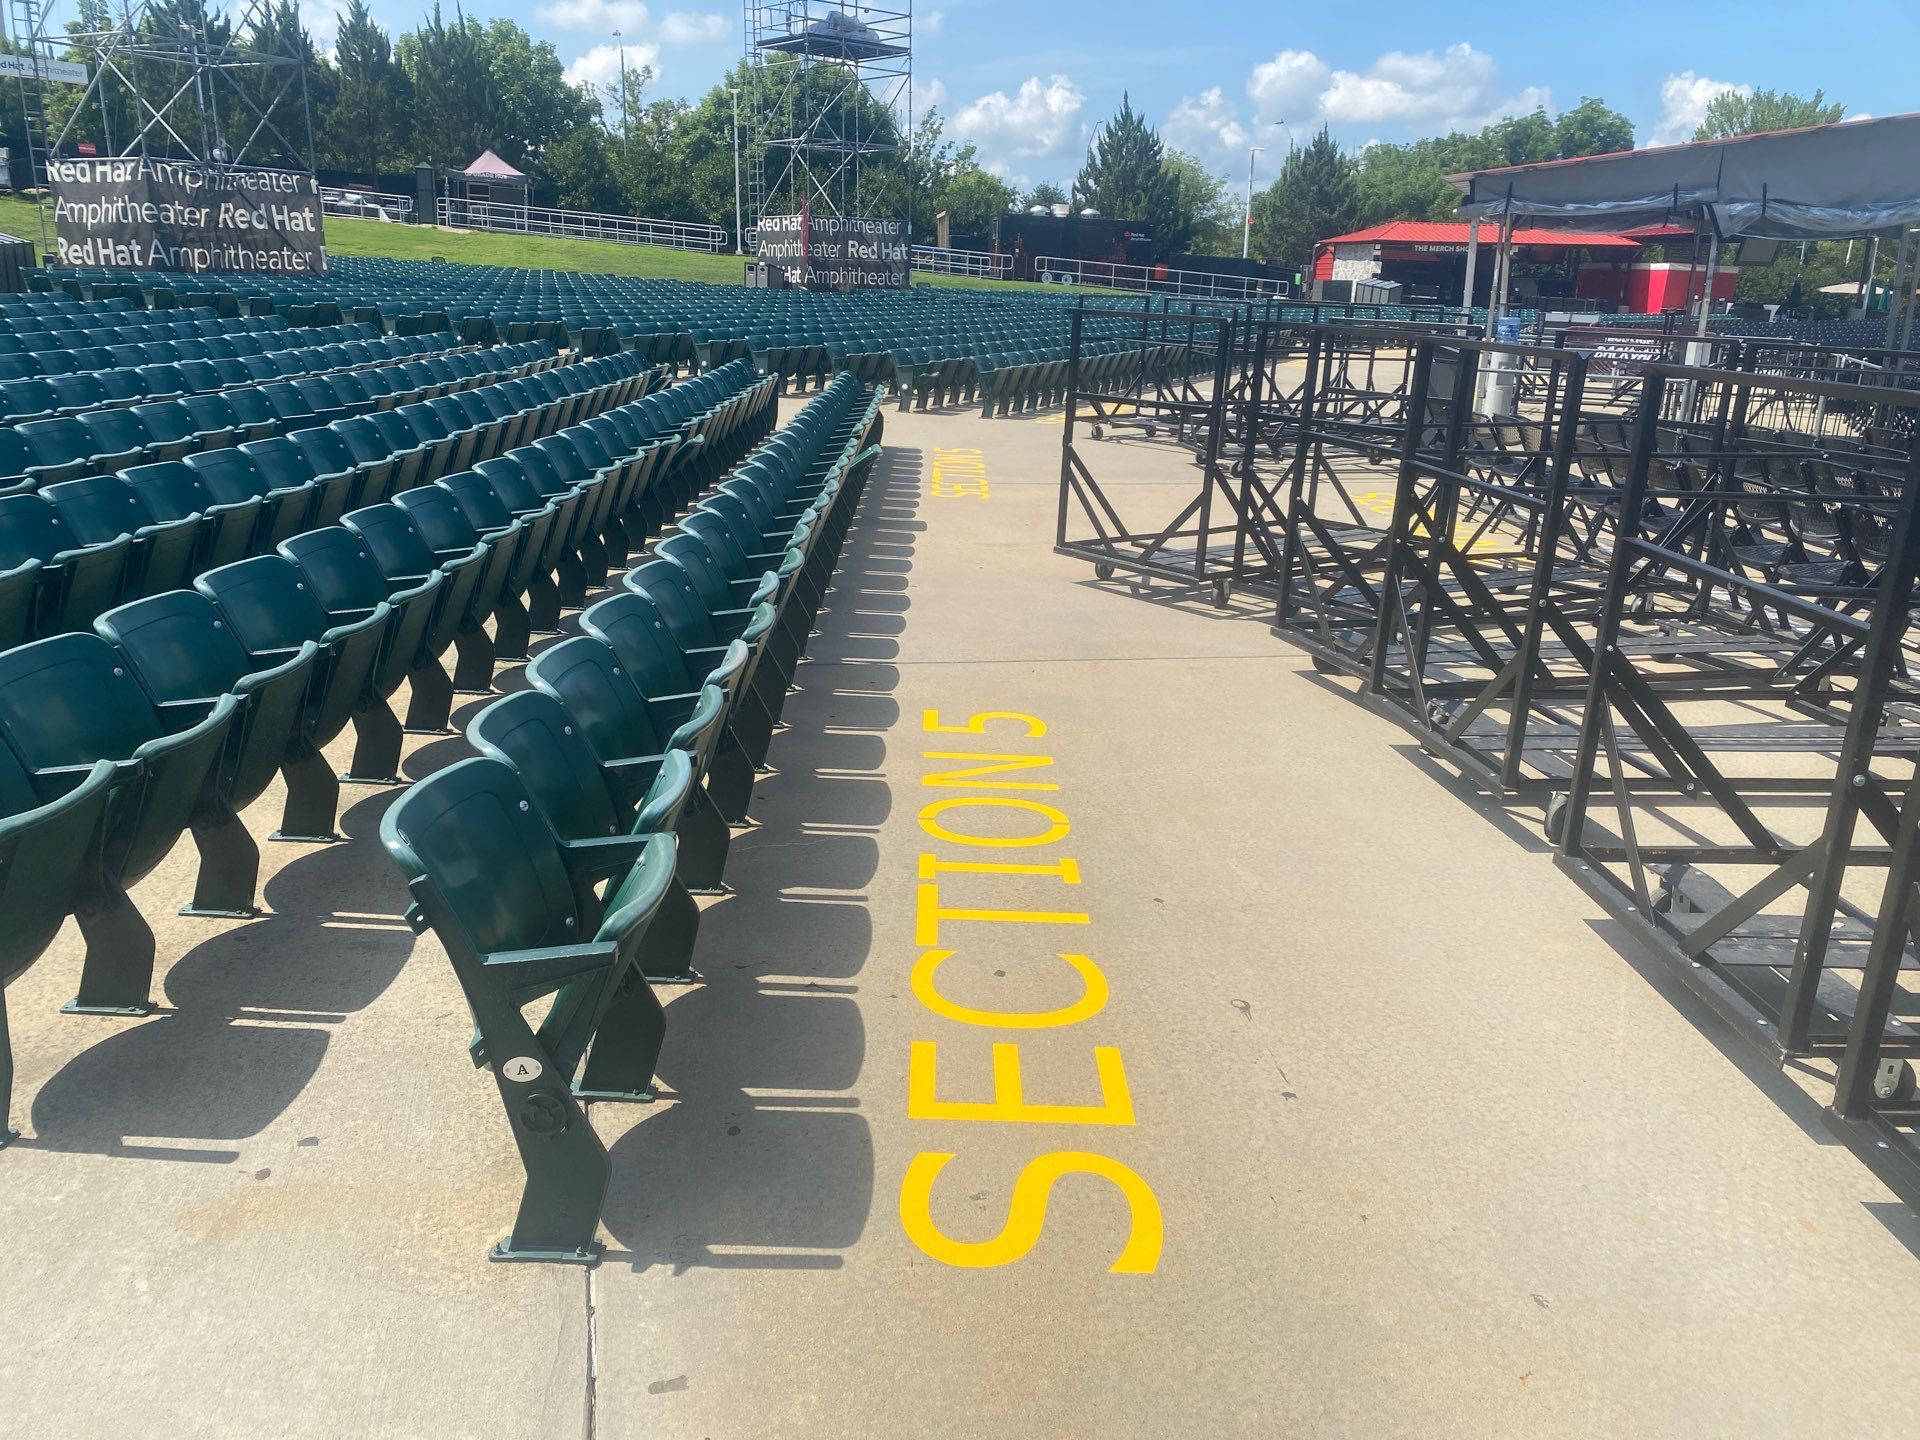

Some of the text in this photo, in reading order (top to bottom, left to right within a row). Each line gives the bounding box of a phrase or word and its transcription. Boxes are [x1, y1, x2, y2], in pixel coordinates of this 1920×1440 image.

[45, 160, 91, 183] Red
[94, 159, 136, 183] Hat
[54, 194, 317, 232] Amphitheater Red Hat
[757, 216, 780, 232] Red
[782, 216, 803, 232] Hat
[57, 236, 96, 266] Red
[96, 237, 144, 267] Hat
[148, 238, 313, 275] Amphitheater
[848, 240, 878, 260] Red
[881, 242, 909, 261] Hat
[1414, 244, 1469, 253] THE MERCH SHO
[804, 264, 906, 289] Amphitheater
[900, 709, 1164, 1274] SECTION 5
[516, 1063, 530, 1076] A
